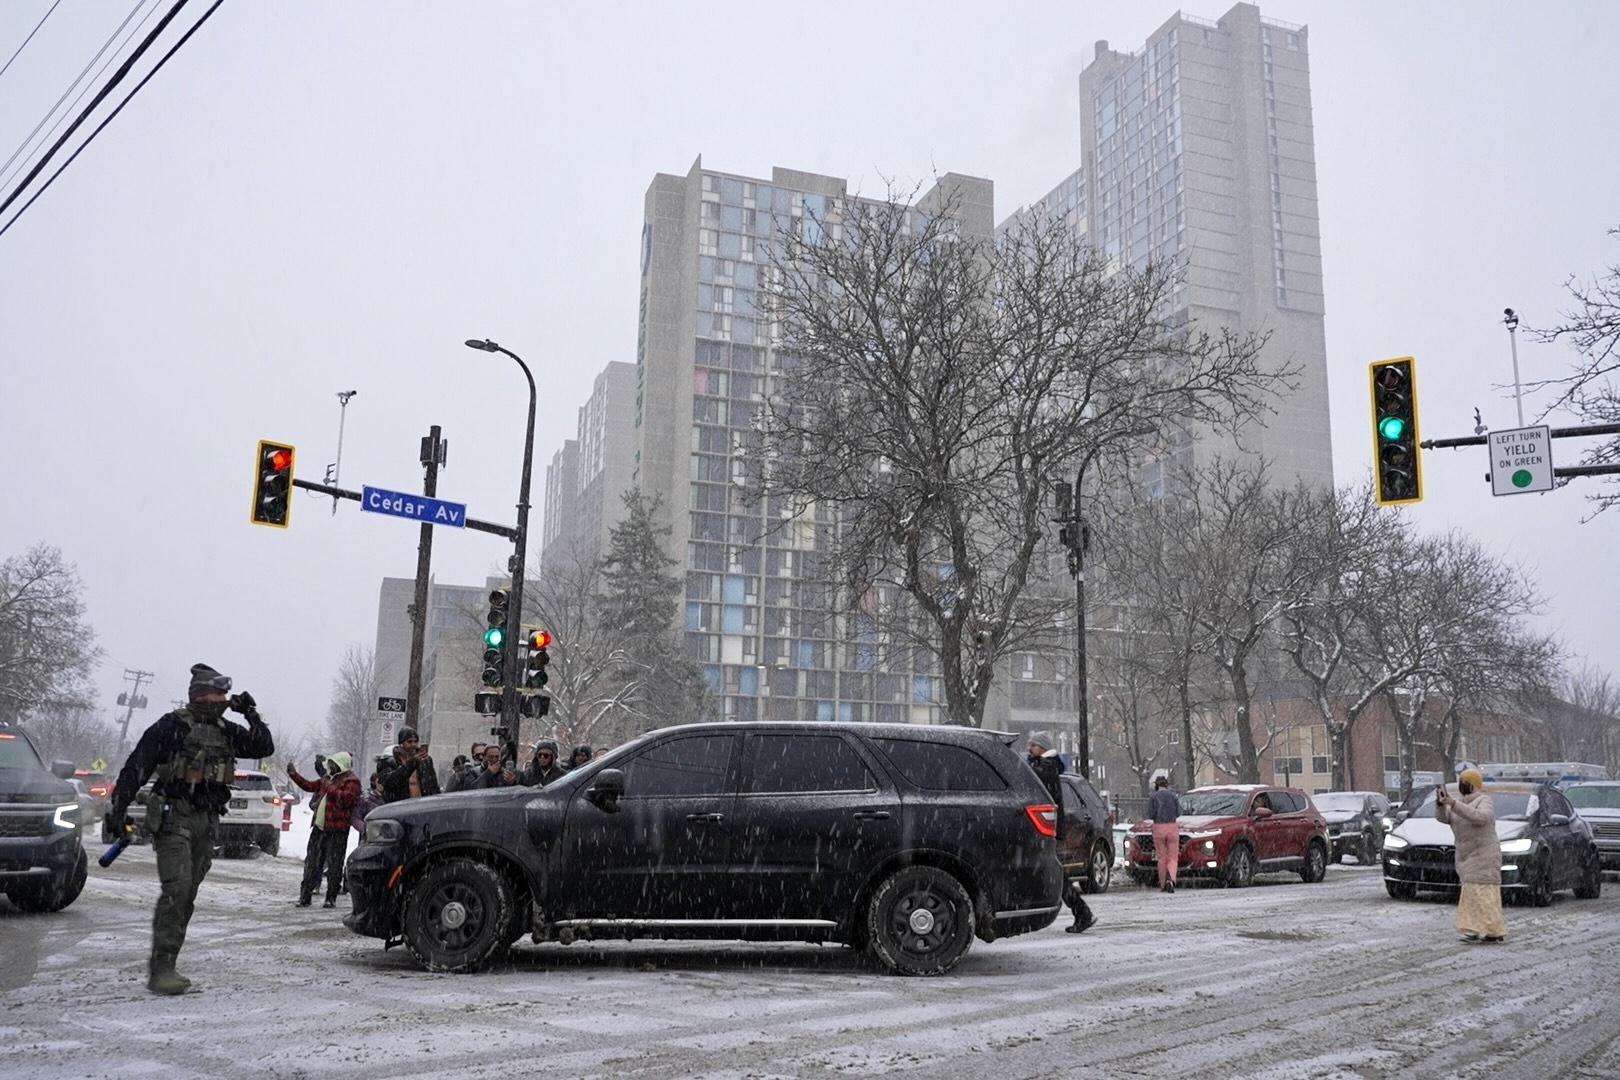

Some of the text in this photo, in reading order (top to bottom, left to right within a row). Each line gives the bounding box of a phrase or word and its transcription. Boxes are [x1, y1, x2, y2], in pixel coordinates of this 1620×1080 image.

[1496, 431, 1542, 444] LEFT TURN
[1503, 443, 1536, 456] YIELD
[1499, 456, 1542, 468] ON GREEN
[369, 492, 459, 522] Cedar Av
